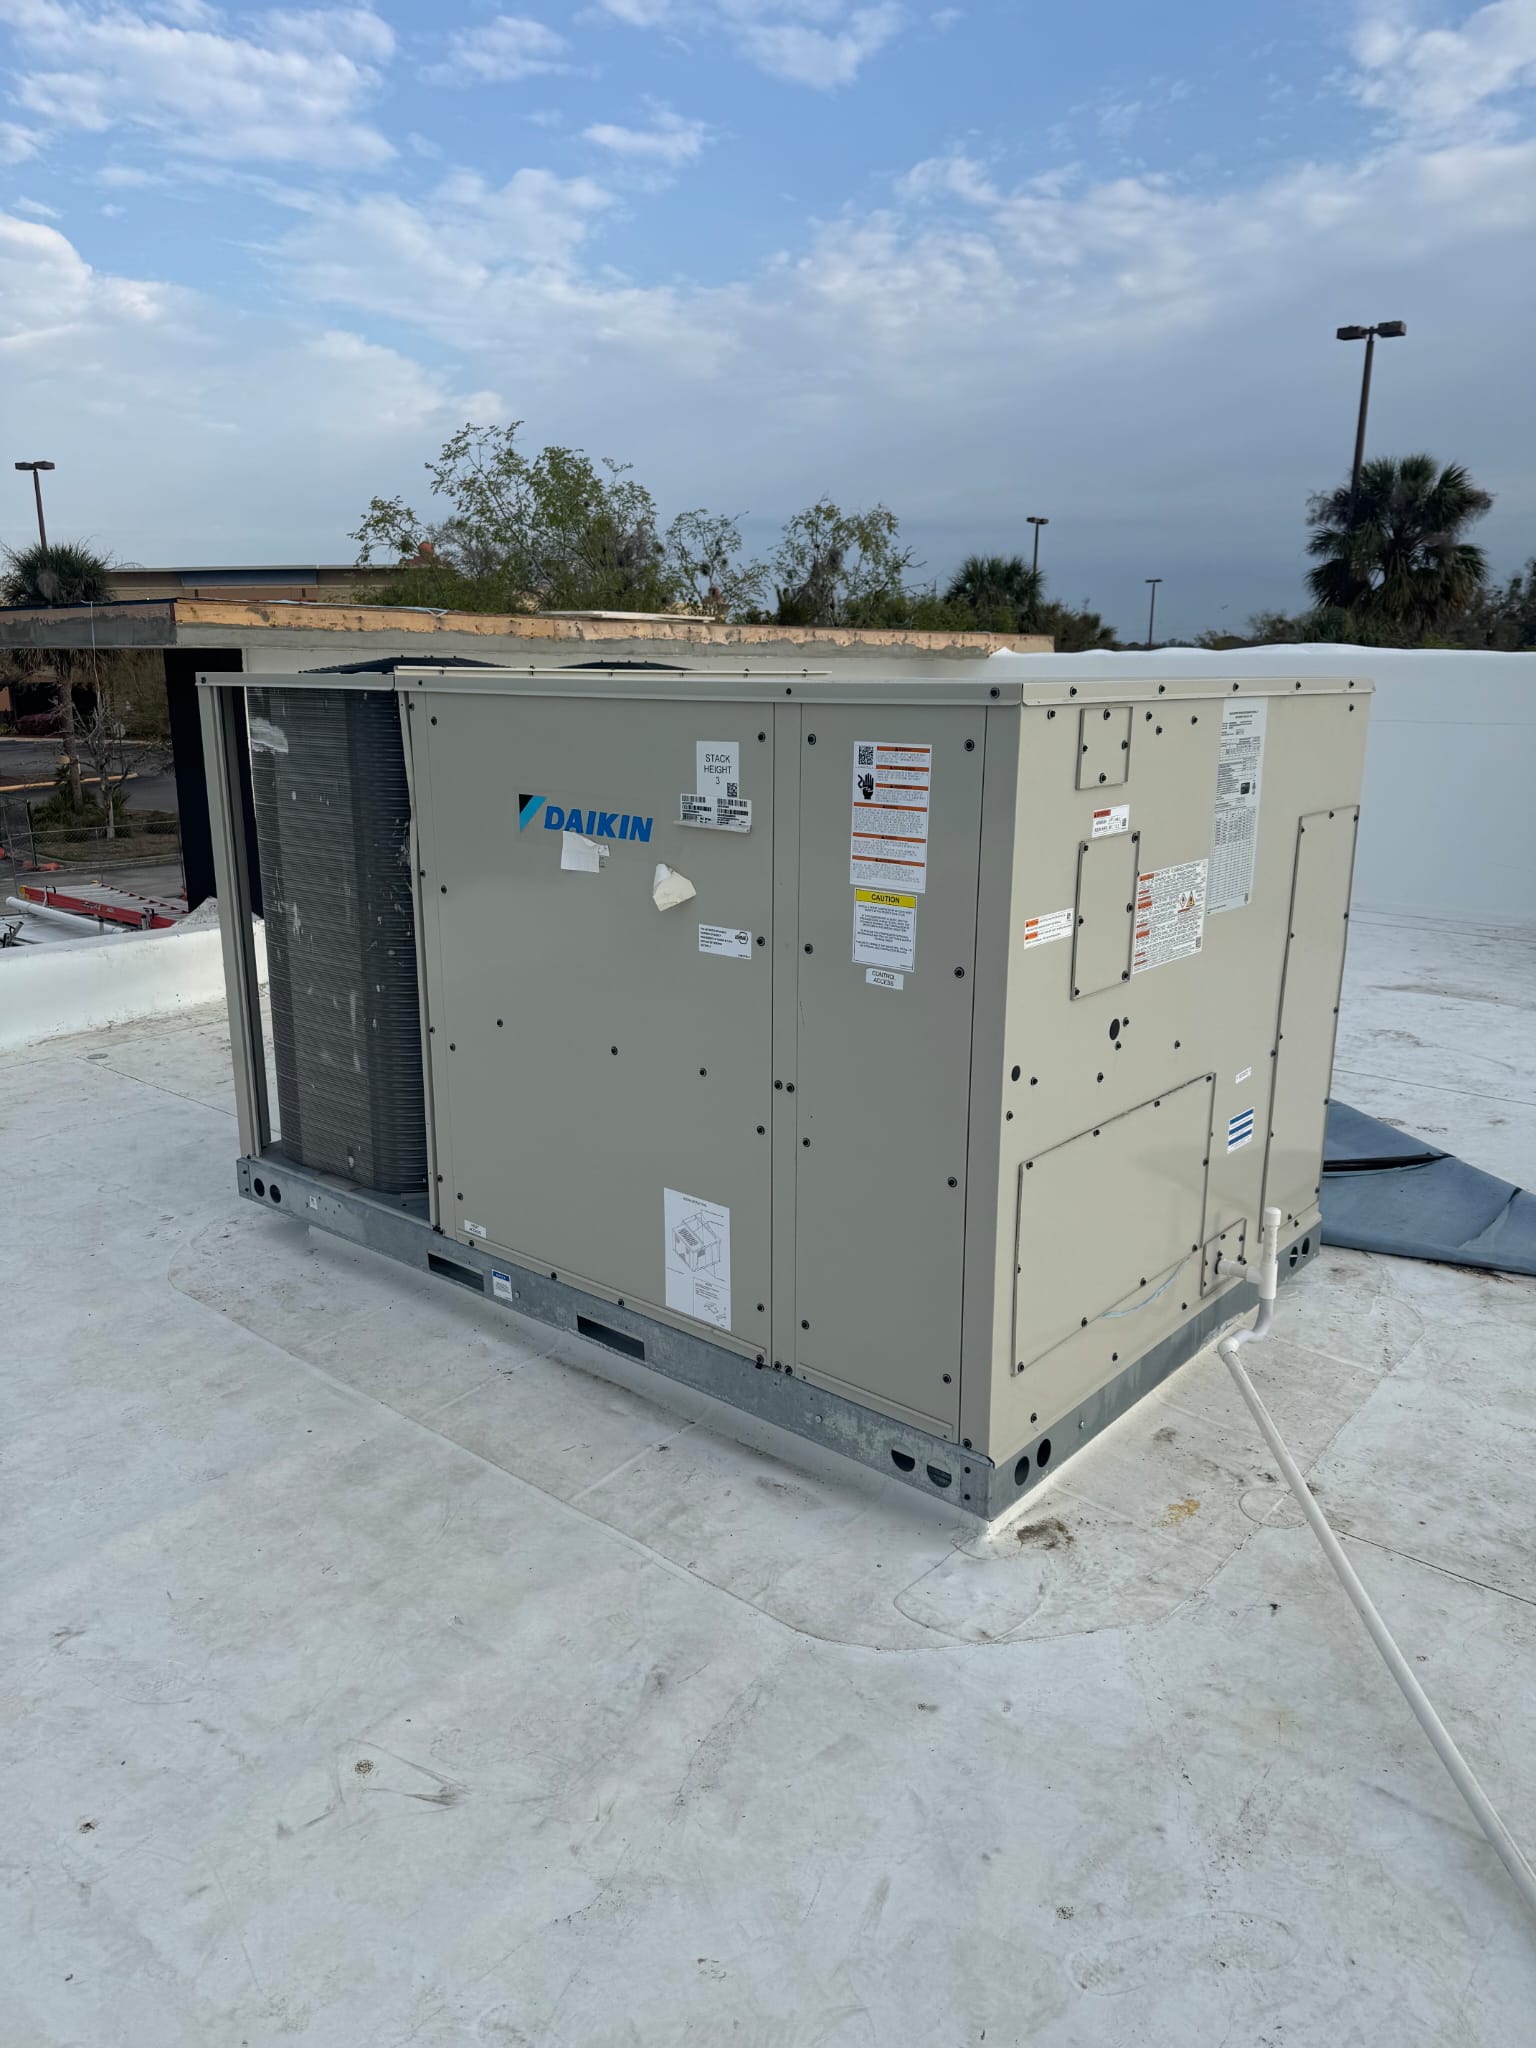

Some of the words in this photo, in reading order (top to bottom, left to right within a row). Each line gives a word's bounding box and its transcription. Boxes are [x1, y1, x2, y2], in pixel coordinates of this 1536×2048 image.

[705, 753, 731, 764] STACK
[703, 765, 732, 775] HEIGHT
[715, 776, 721, 785] 3
[544, 805, 654, 843] DAIKIN
[871, 893, 900, 904] CAUTION
